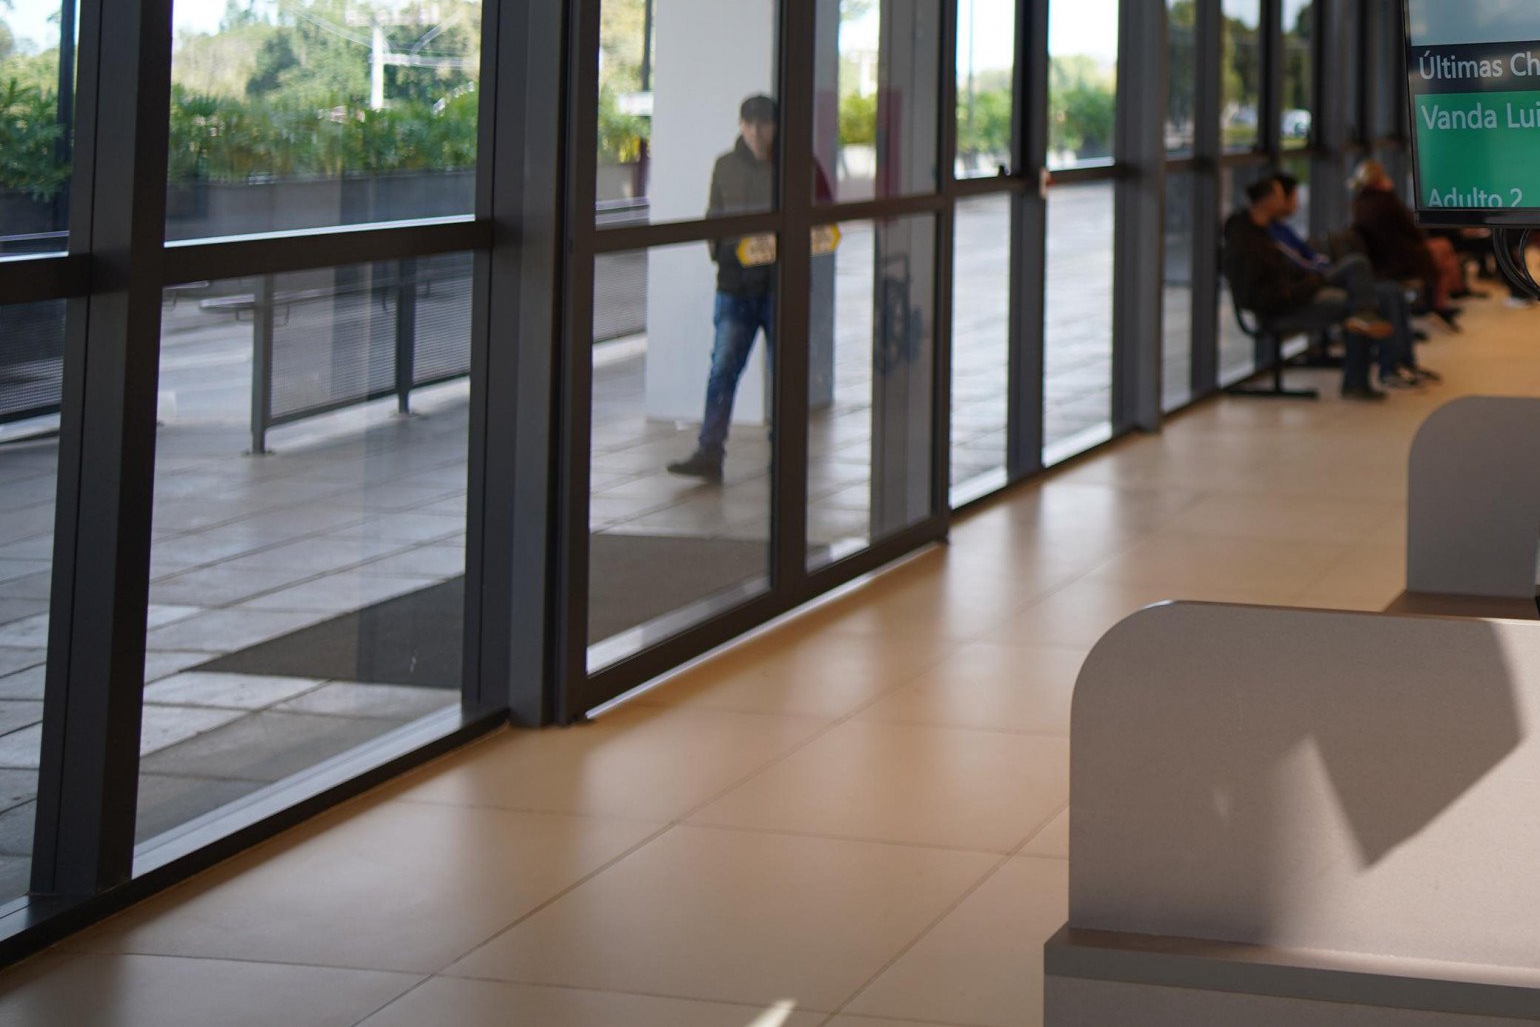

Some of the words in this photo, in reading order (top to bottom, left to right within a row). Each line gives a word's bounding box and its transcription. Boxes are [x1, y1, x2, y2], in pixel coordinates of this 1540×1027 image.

[1419, 49, 1504, 80] Últimas
[1421, 101, 1498, 131] Vanda
[1427, 187, 1502, 207] Adulto
[1510, 188, 1523, 207] 2
